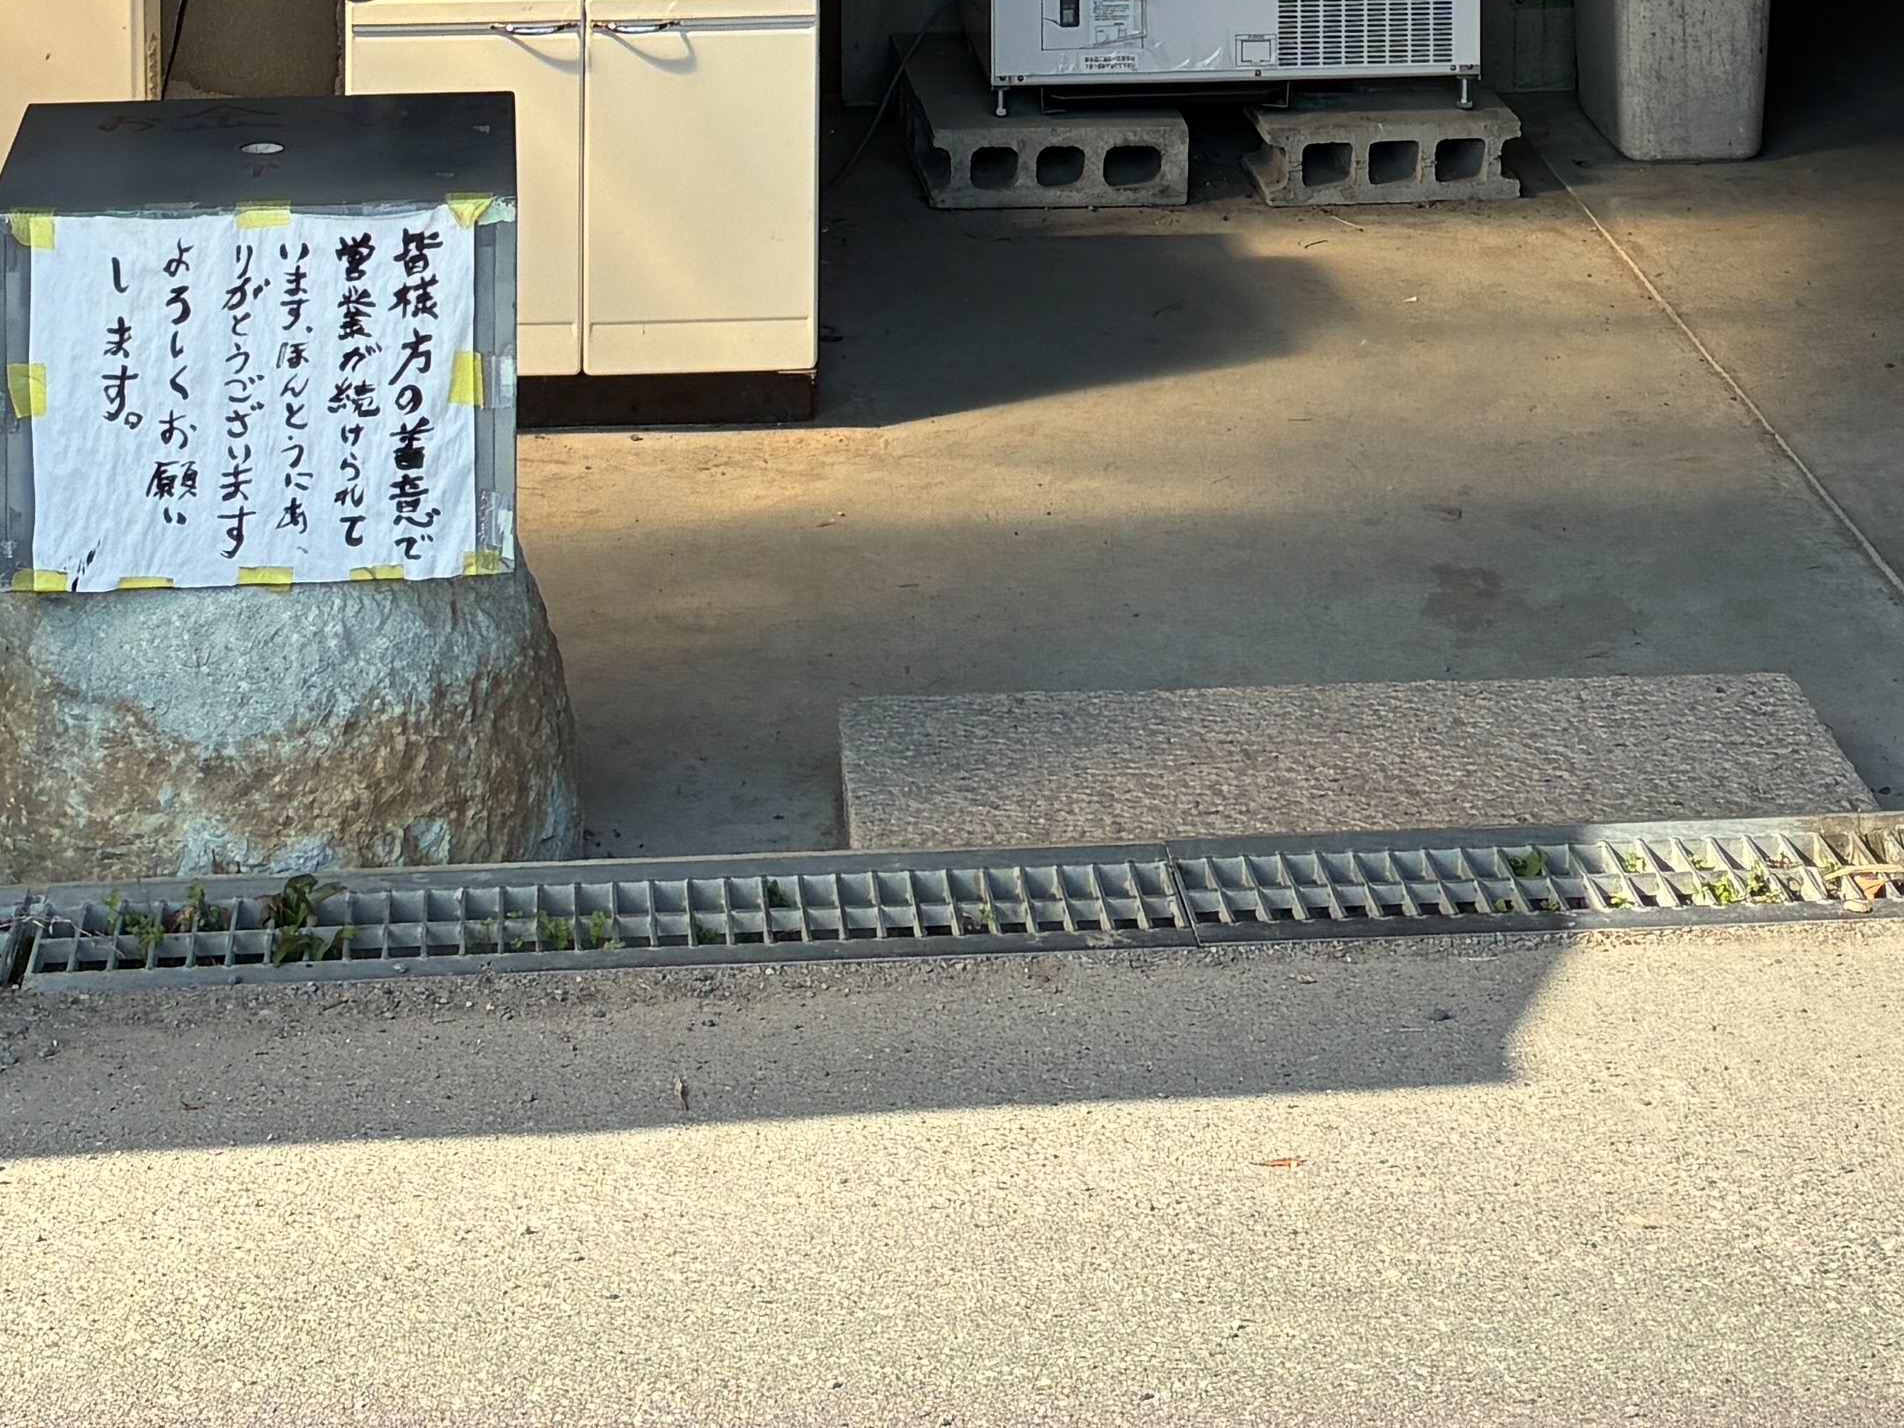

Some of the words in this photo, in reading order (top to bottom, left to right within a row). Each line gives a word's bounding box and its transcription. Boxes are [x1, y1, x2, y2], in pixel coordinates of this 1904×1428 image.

[100, 254, 144, 429] します。
[145, 237, 200, 528] よろしくお願い
[216, 244, 270, 560] りがとうございます
[327, 231, 383, 548] 営業が続けられて
[388, 227, 444, 561] 皆様方の善意で
